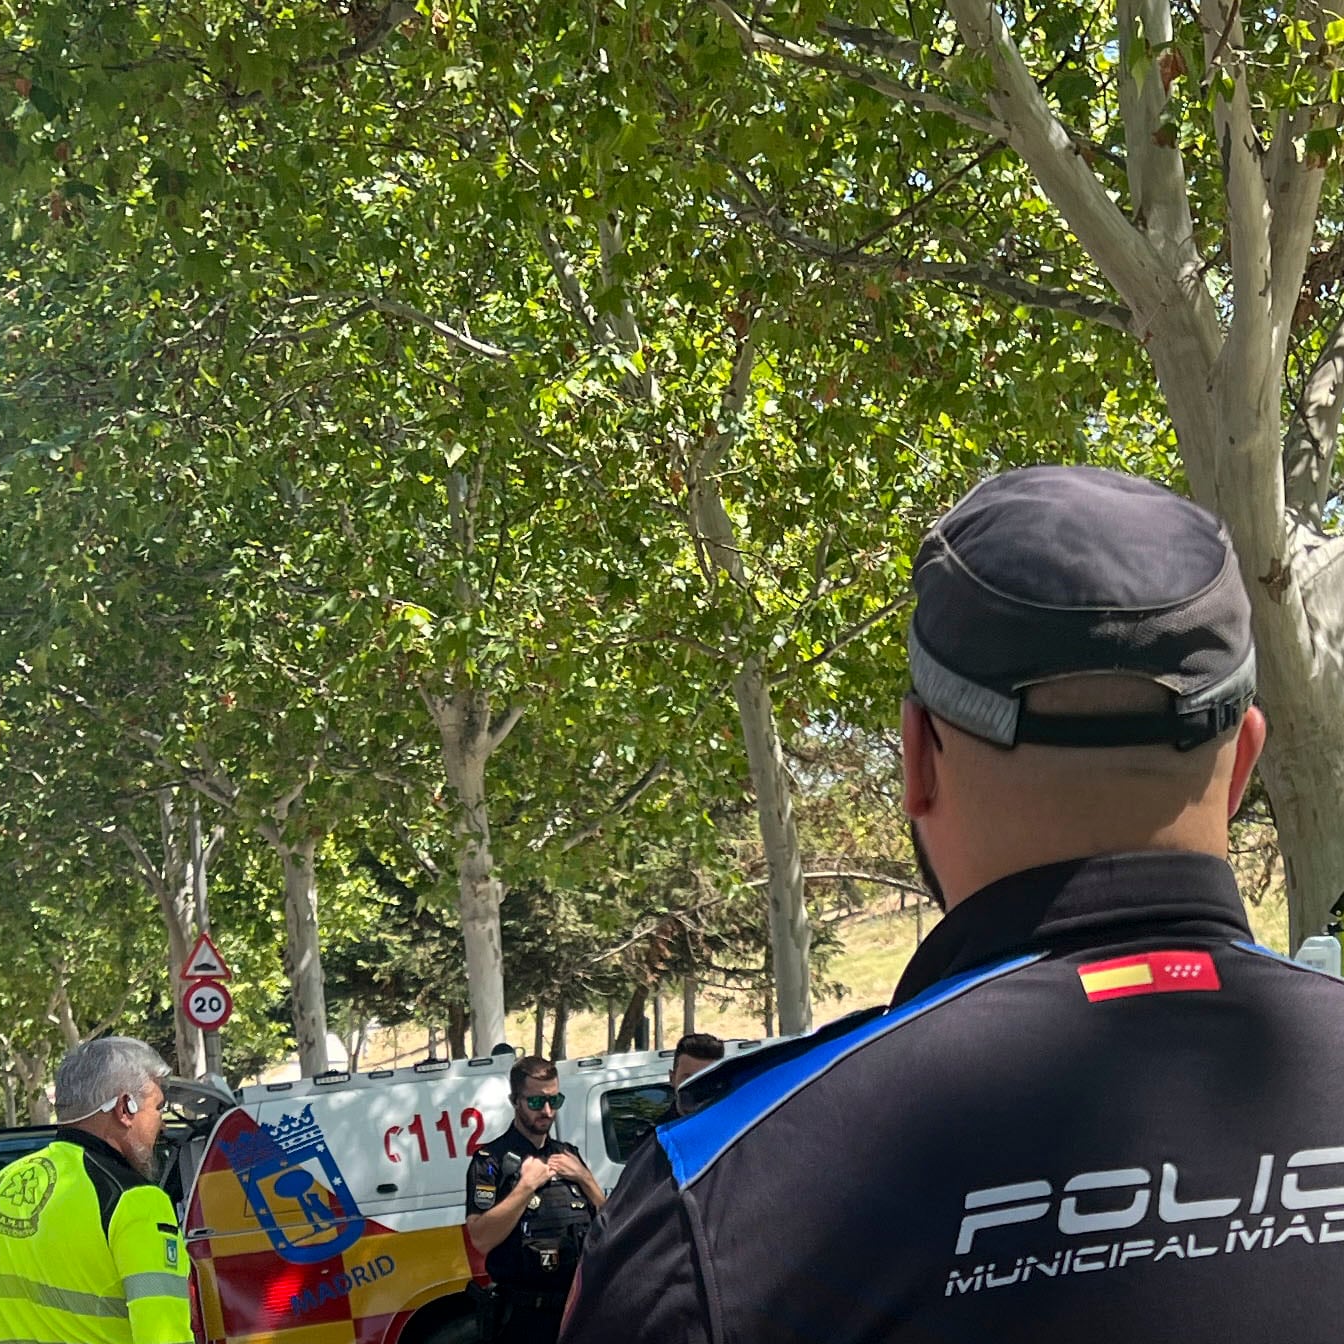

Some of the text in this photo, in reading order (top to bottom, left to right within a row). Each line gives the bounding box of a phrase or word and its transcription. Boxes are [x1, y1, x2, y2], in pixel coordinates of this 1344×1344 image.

[194, 996, 222, 1013] 20
[407, 1106, 486, 1163] 112
[290, 1254, 396, 1316] MADRID
[944, 1234, 1219, 1297] MUNICIPAL
